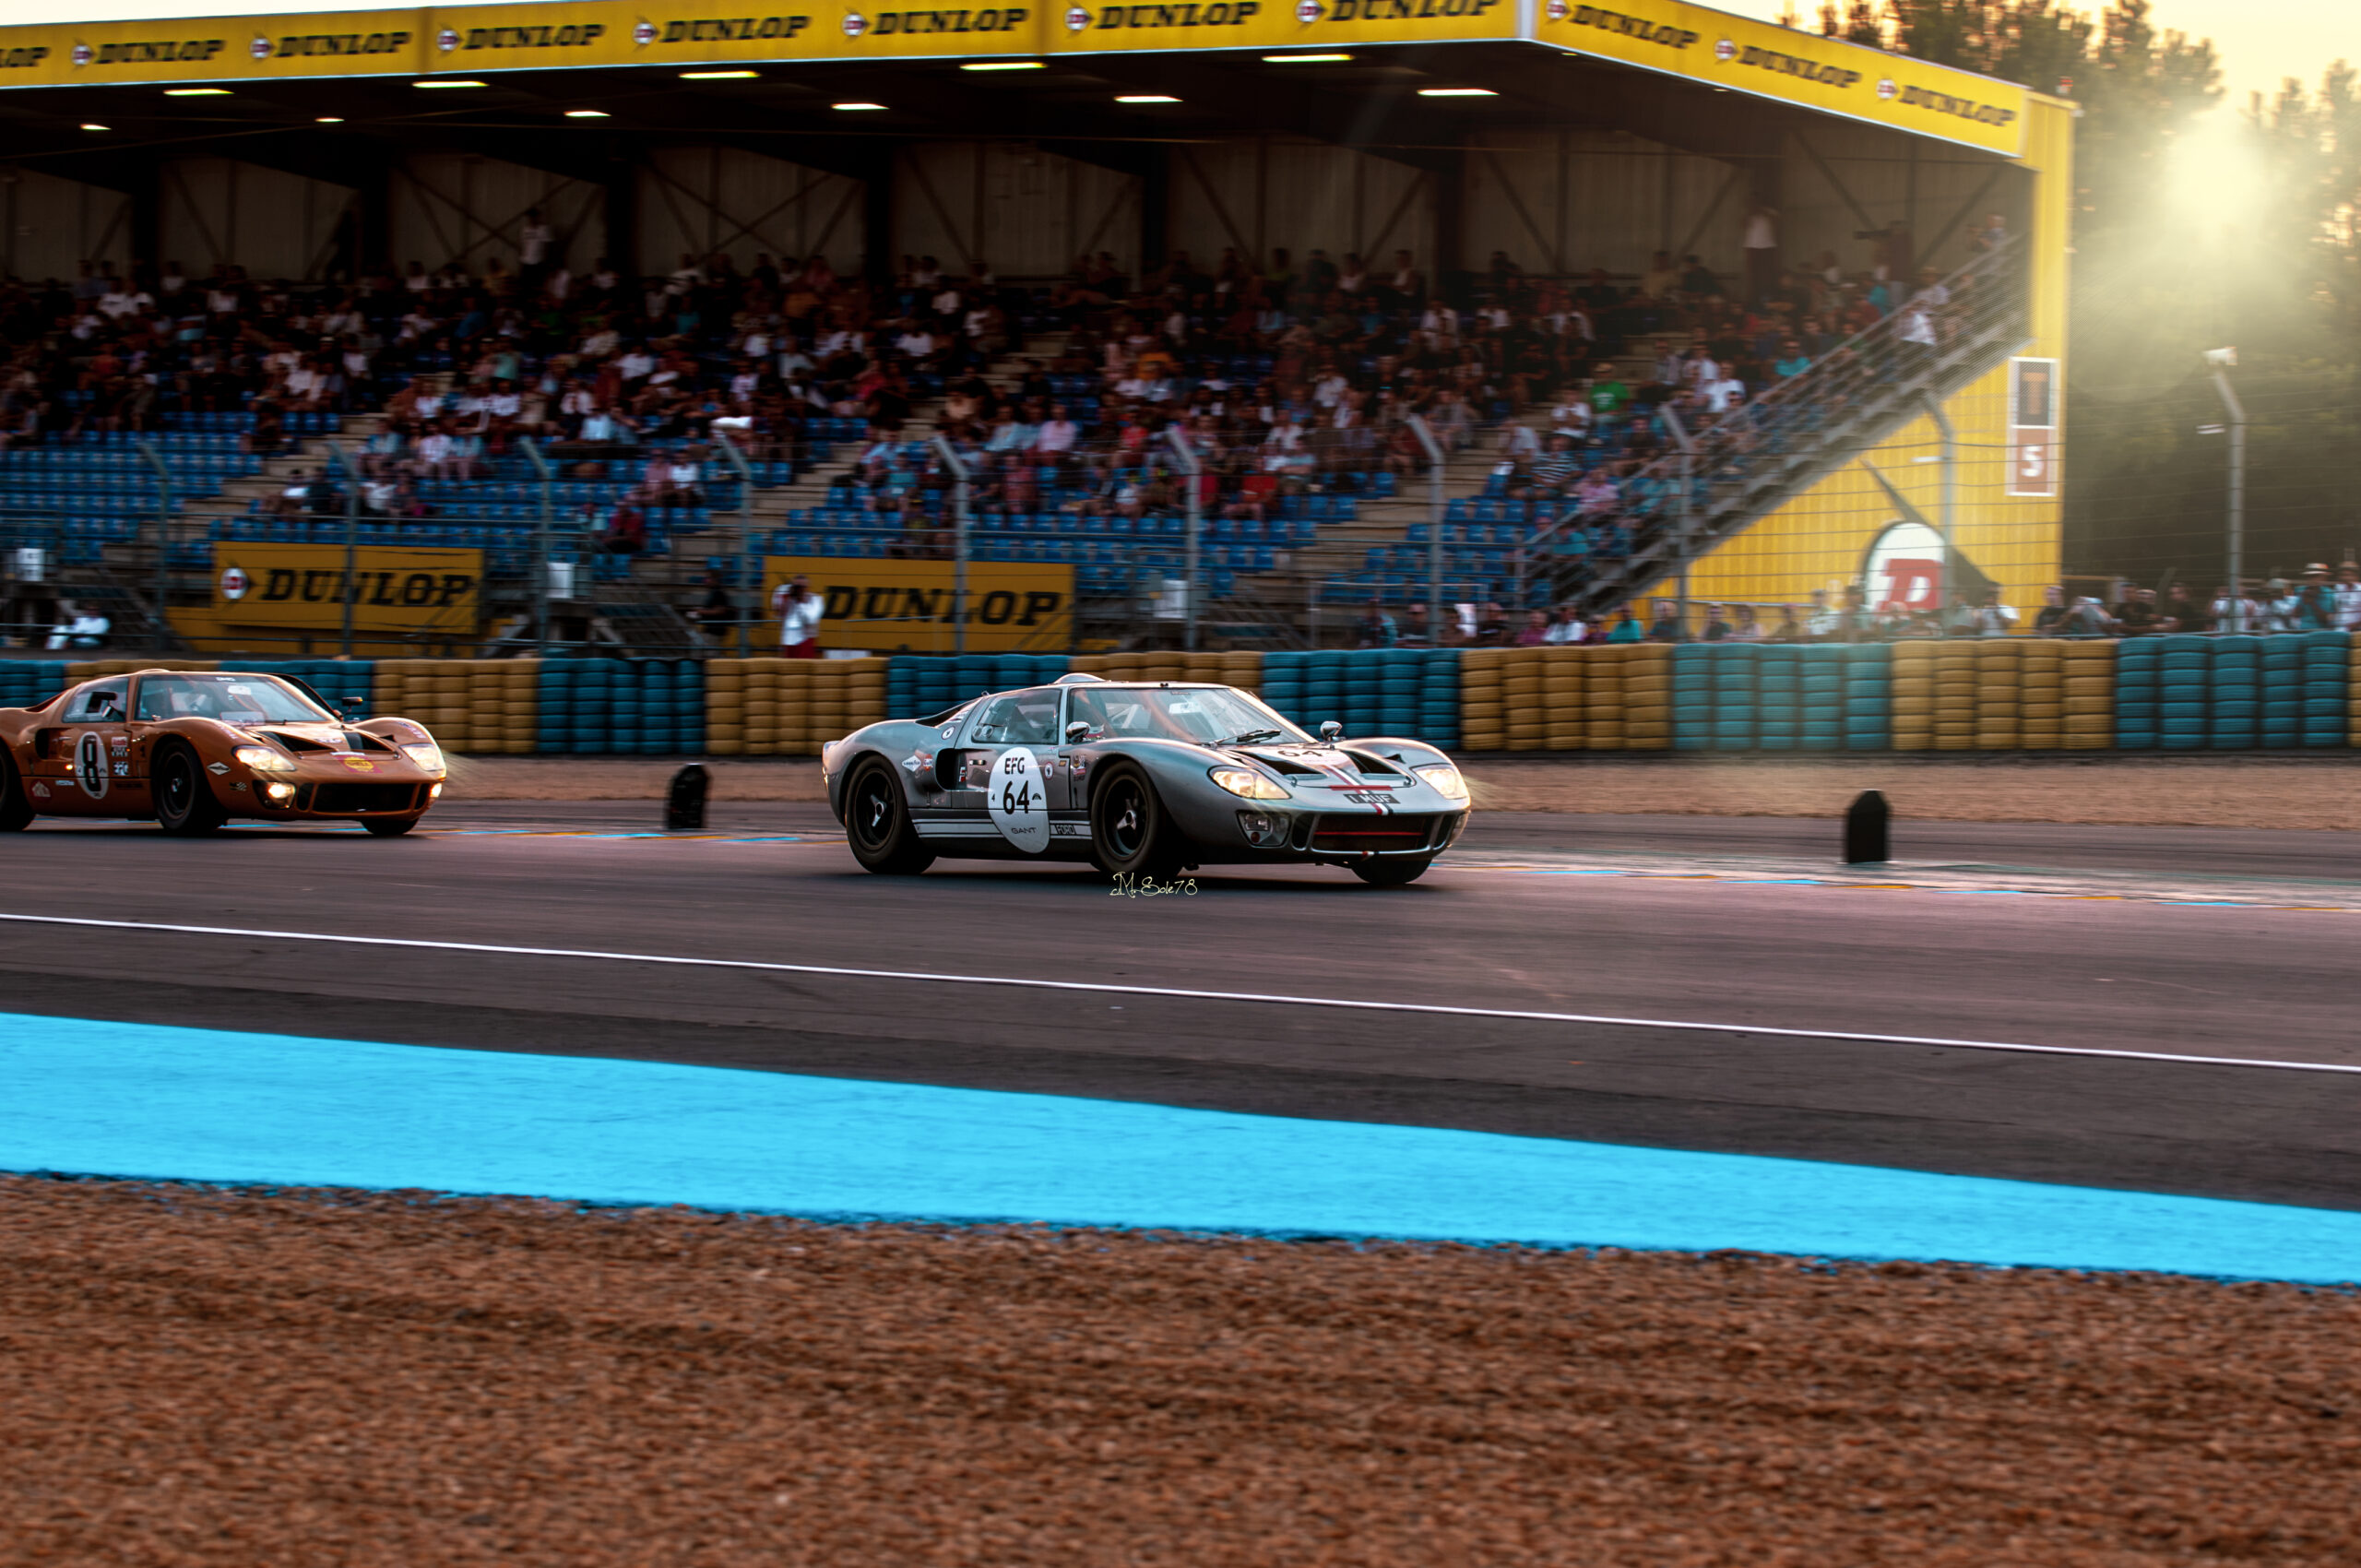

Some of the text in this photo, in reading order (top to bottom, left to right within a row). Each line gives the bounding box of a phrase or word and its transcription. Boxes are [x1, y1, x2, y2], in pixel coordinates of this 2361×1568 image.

[870, 8, 1028, 35] DUNLOP
[1094, 2, 1261, 29] DUNLOP
[1326, 0, 1503, 22] DUNLOP
[462, 24, 604, 50] DUNLOP
[659, 16, 811, 42] DUNLOP
[1568, 5, 1700, 50] DUNLOP
[95, 40, 226, 64] DUNLOP
[275, 32, 411, 57] DUNLOP
[1737, 45, 1862, 89] DUNLOP
[1896, 84, 2016, 126] DUNLOP
[2021, 445, 2043, 477] 5
[262, 568, 472, 607] DUNLOP
[81, 734, 102, 792] 8
[1004, 757, 1025, 774] EFG
[1003, 780, 1030, 814] 64
